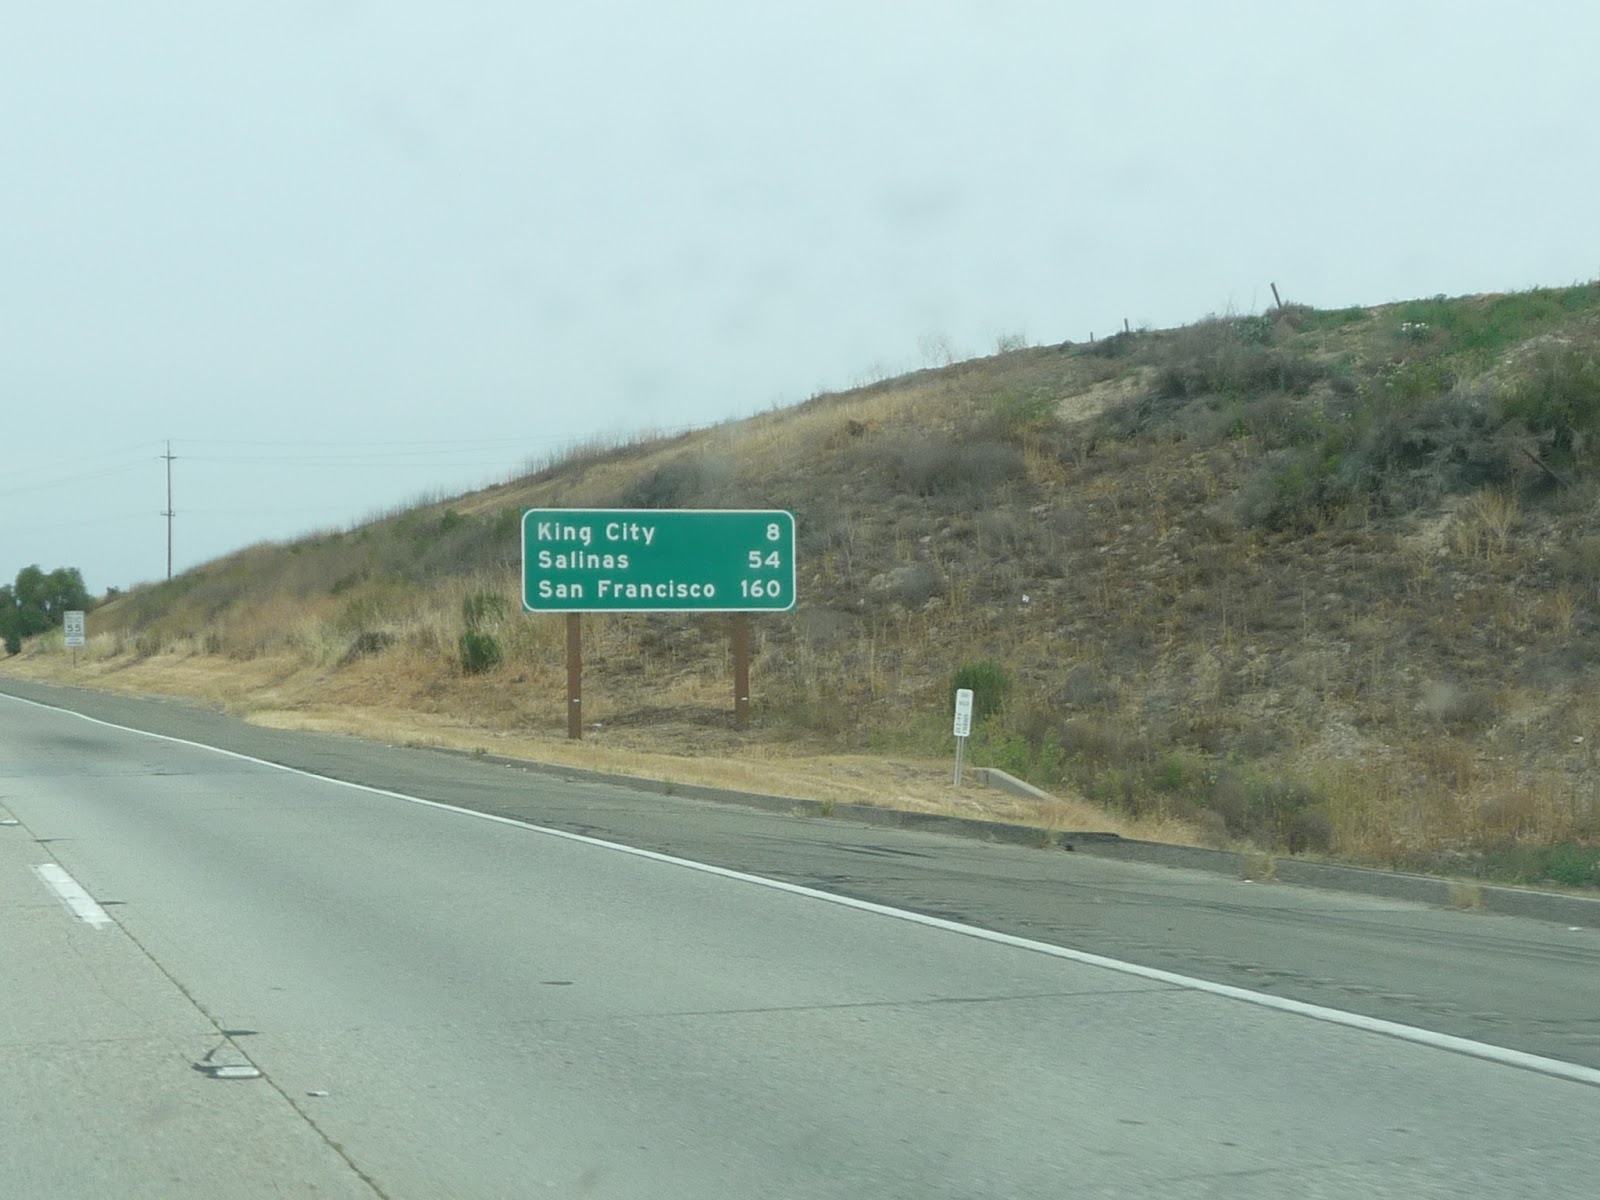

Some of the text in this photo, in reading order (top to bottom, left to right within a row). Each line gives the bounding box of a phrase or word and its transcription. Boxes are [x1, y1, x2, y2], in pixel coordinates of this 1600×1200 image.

[537, 522, 781, 546] King City 8
[538, 550, 781, 569] Salinas 54
[538, 579, 781, 598] San Francisco 160
